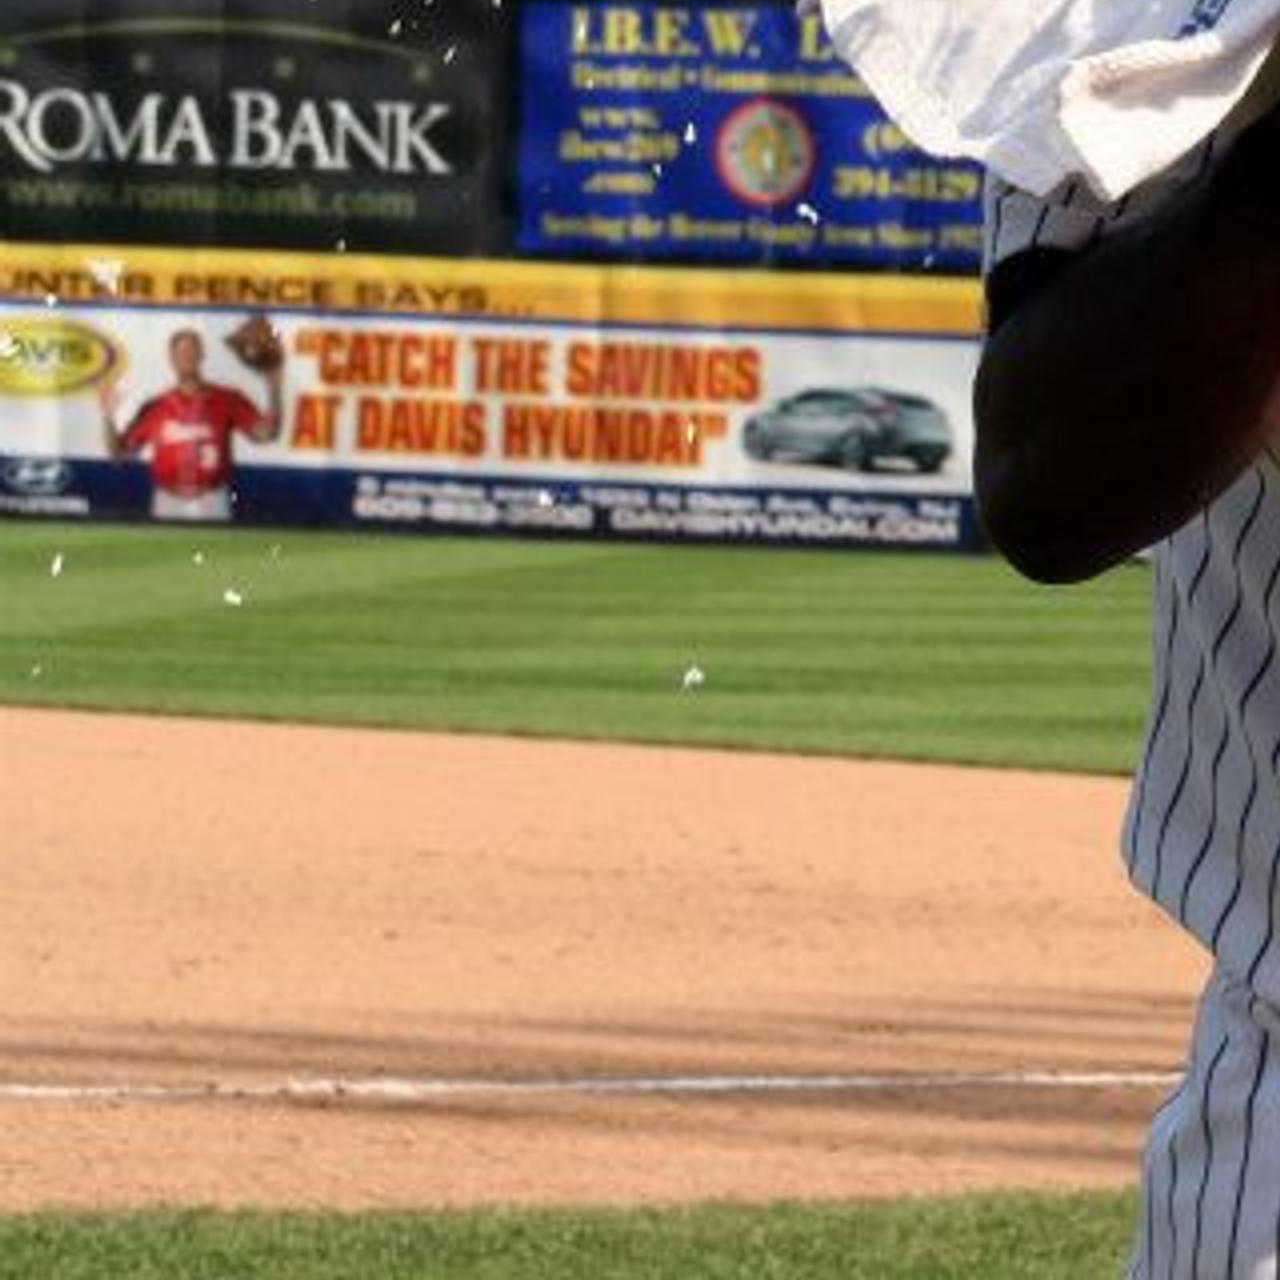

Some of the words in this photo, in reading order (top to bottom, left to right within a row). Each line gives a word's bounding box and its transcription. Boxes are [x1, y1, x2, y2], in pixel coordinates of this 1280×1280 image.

[229, 88, 452, 175] BANK
[174, 275, 337, 305] PENCE
[474, 337, 554, 395] THE
[566, 342, 761, 405] SAVINGS
[292, 393, 340, 450] AT
[356, 398, 486, 459] DAVIS
